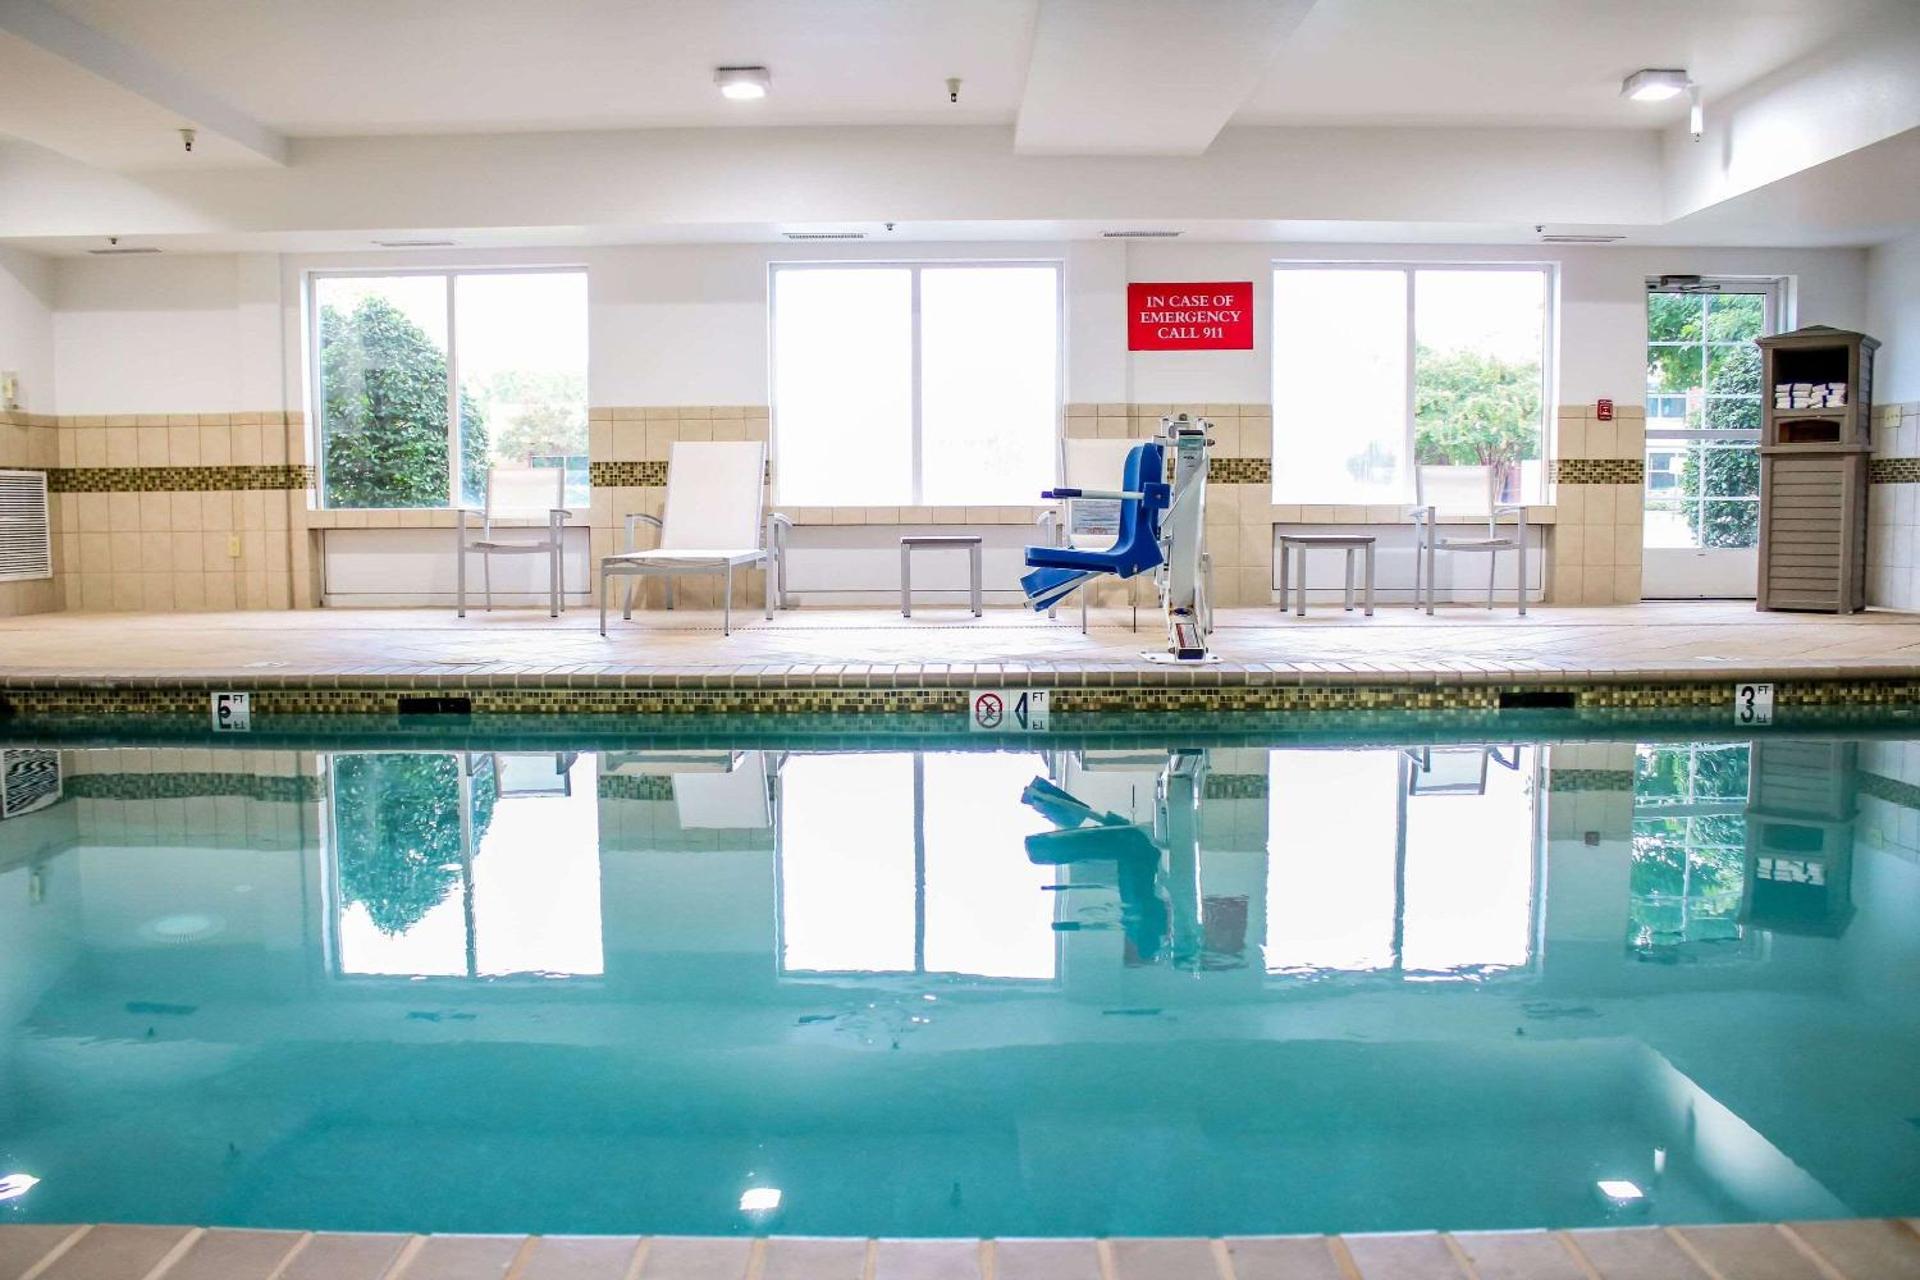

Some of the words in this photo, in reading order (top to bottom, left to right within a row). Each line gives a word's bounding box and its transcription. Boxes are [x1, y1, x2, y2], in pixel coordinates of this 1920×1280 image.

[1147, 296, 1165, 307] IN
[1169, 295, 1209, 307] CASE
[1213, 295, 1234, 306] OF
[1140, 310, 1242, 324] EMERGENCY
[1157, 327, 1200, 339] CALL
[1203, 327, 1224, 338] 911
[1758, 685, 1769, 694] FT
[233, 694, 244, 704] FT
[1032, 692, 1045, 702] FT
